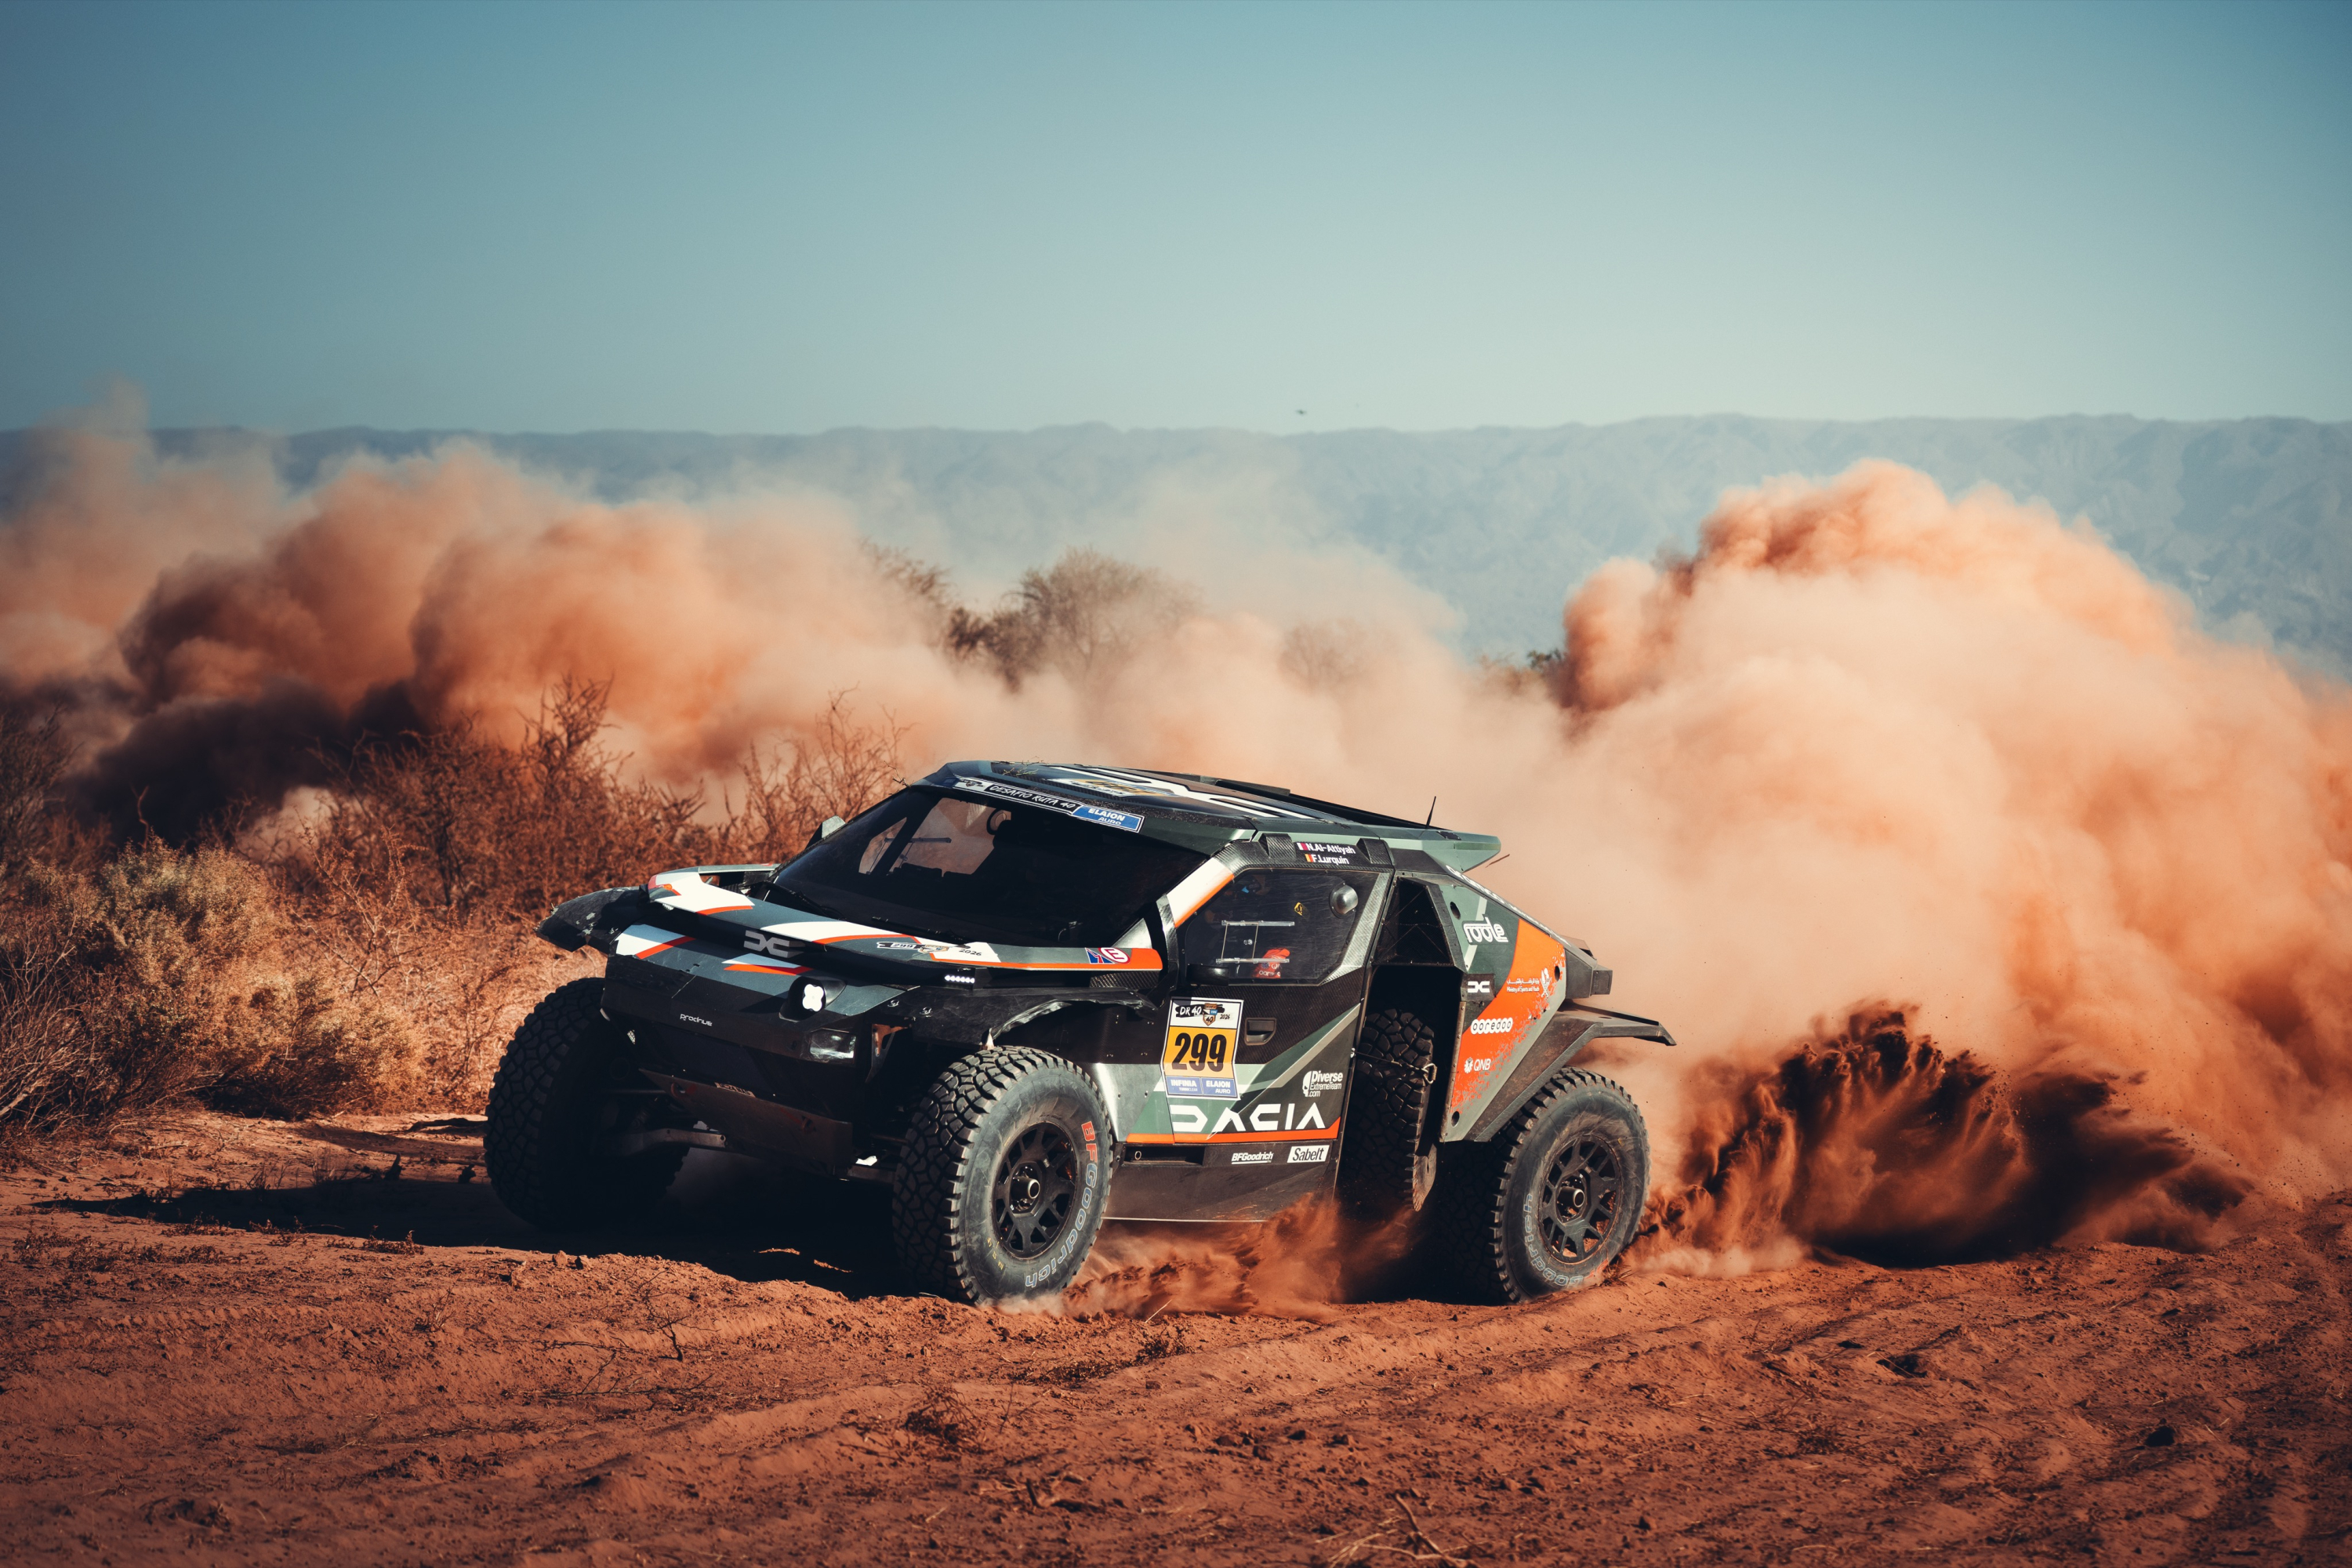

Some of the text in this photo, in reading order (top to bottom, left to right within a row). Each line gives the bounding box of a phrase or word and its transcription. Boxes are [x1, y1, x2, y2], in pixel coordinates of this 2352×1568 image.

[989, 785, 1033, 798] DESAFIO
[1032, 795, 1058, 805] RUTA
[1087, 808, 1126, 822] ELAION
[1098, 816, 1121, 826] AURO
[1179, 1006, 1202, 1016] DR 40
[1472, 1020, 1512, 1032] ooredoo
[1171, 1033, 1227, 1073] 299
[1474, 1058, 1491, 1072] QNB
[1171, 1079, 1197, 1087] INFINIA
[1311, 1070, 1343, 1082] Diverse
[1170, 1102, 1326, 1133] DACIA
[1231, 1151, 1274, 1162] BFGoodrich
[1293, 1147, 1325, 1161] Sabelt
[1025, 1120, 1098, 1288] BFGoodrich
[1523, 1193, 1608, 1287] Goodrich
